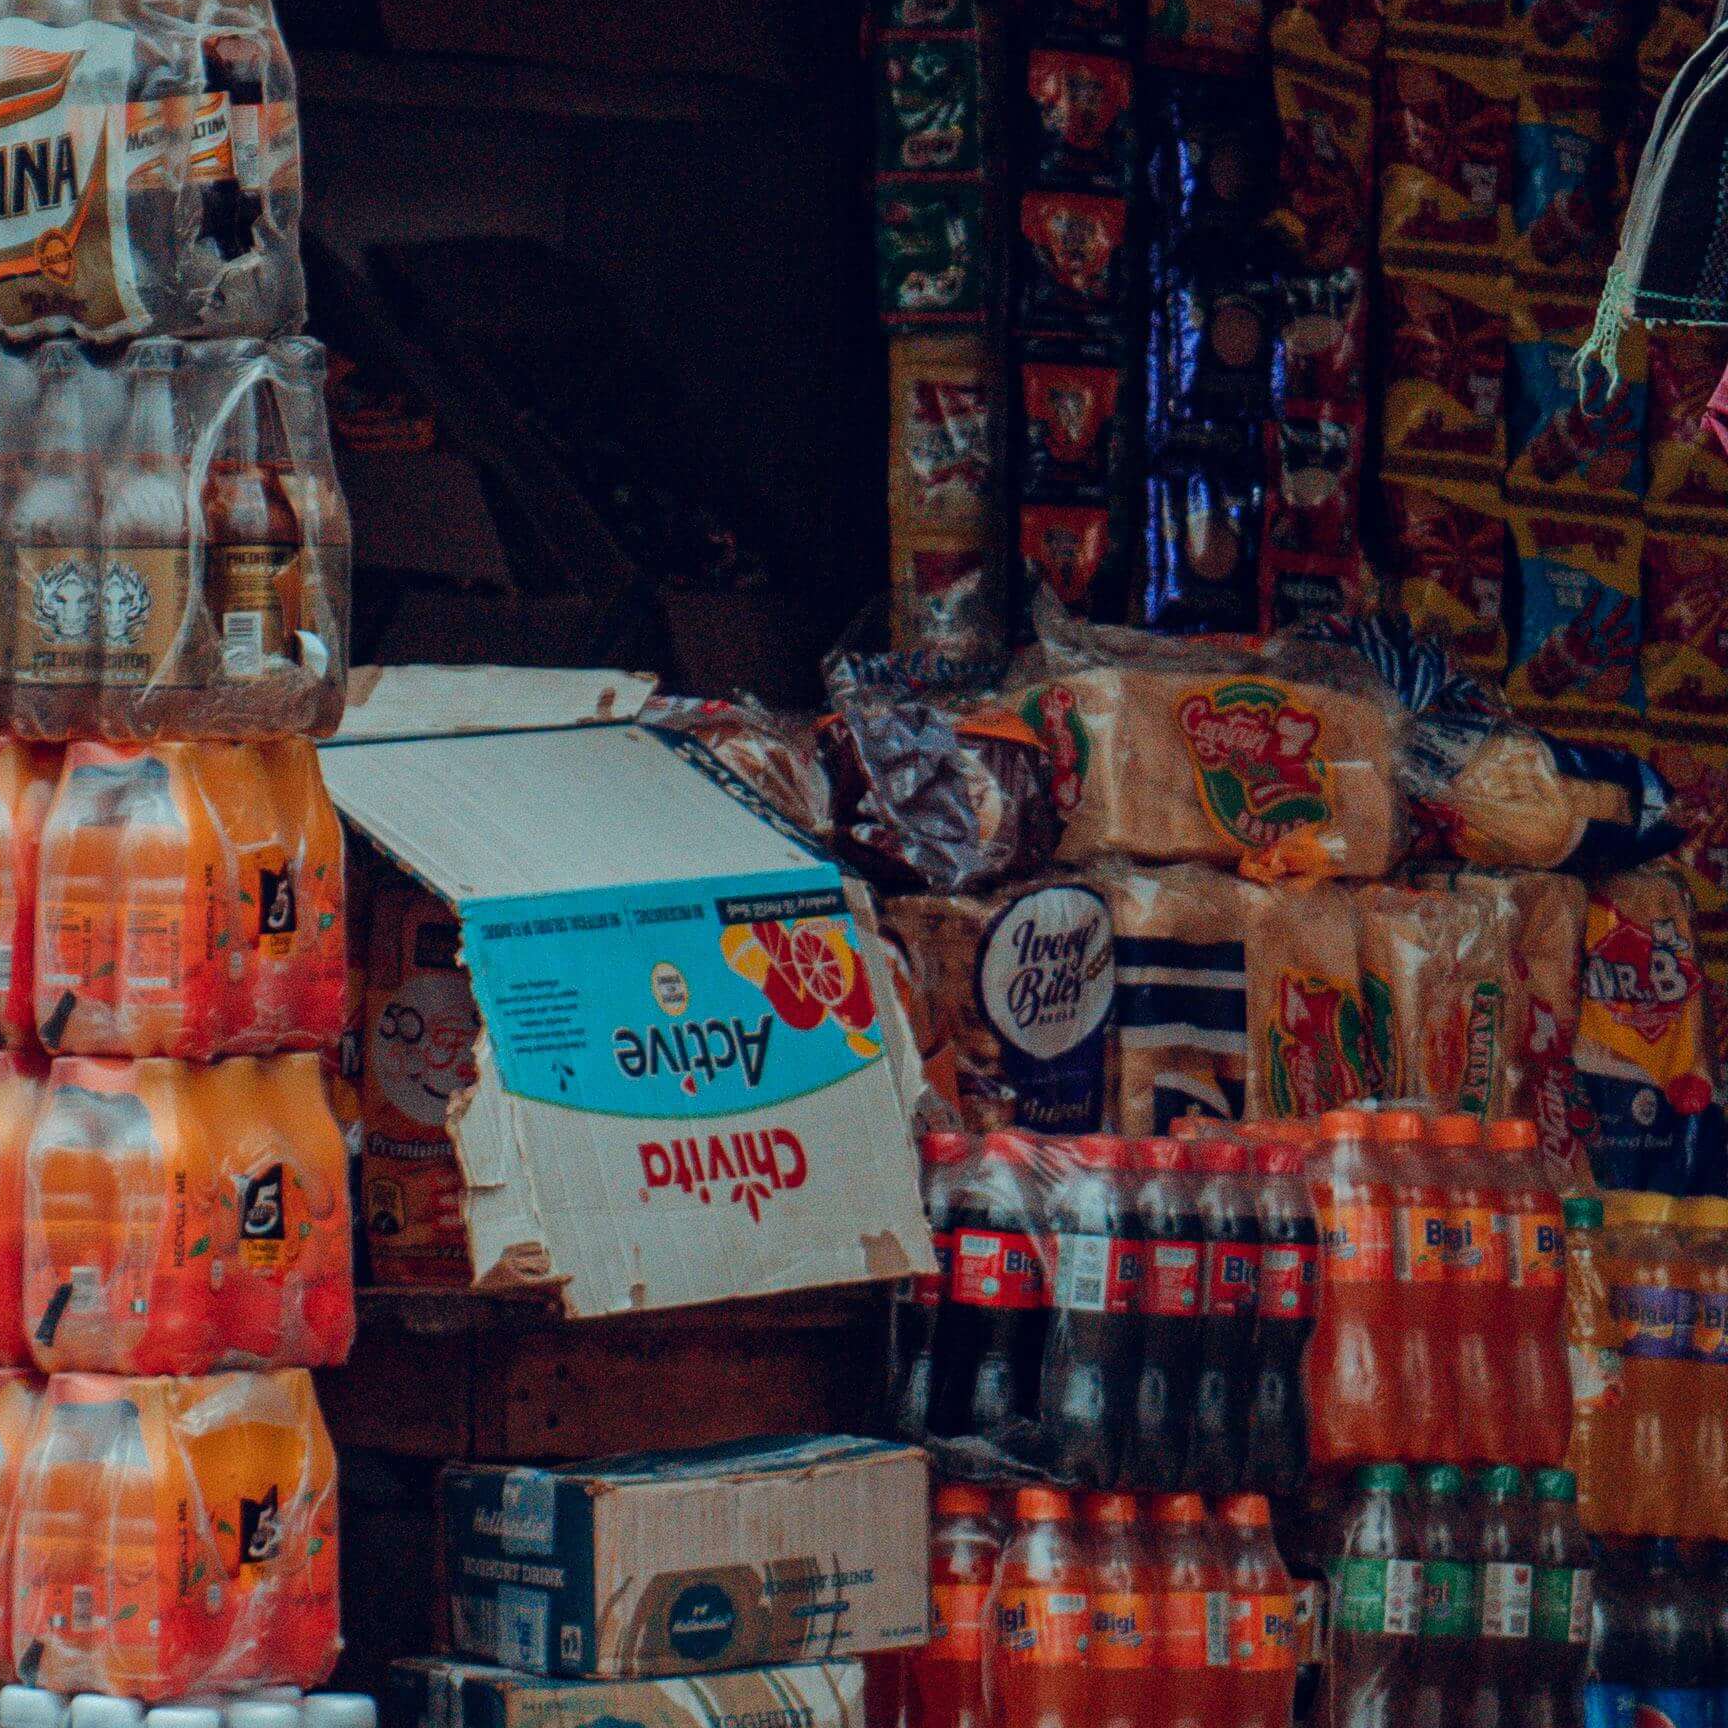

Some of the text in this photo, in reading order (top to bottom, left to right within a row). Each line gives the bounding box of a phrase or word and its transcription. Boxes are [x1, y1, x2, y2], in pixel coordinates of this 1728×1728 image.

[1012, 917, 1100, 971] Ivory
[1007, 967, 1084, 1029] Bites
[613, 1013, 773, 1088] Active
[638, 1128, 808, 1206] Chivita
[1424, 1219, 1473, 1251] Bigi
